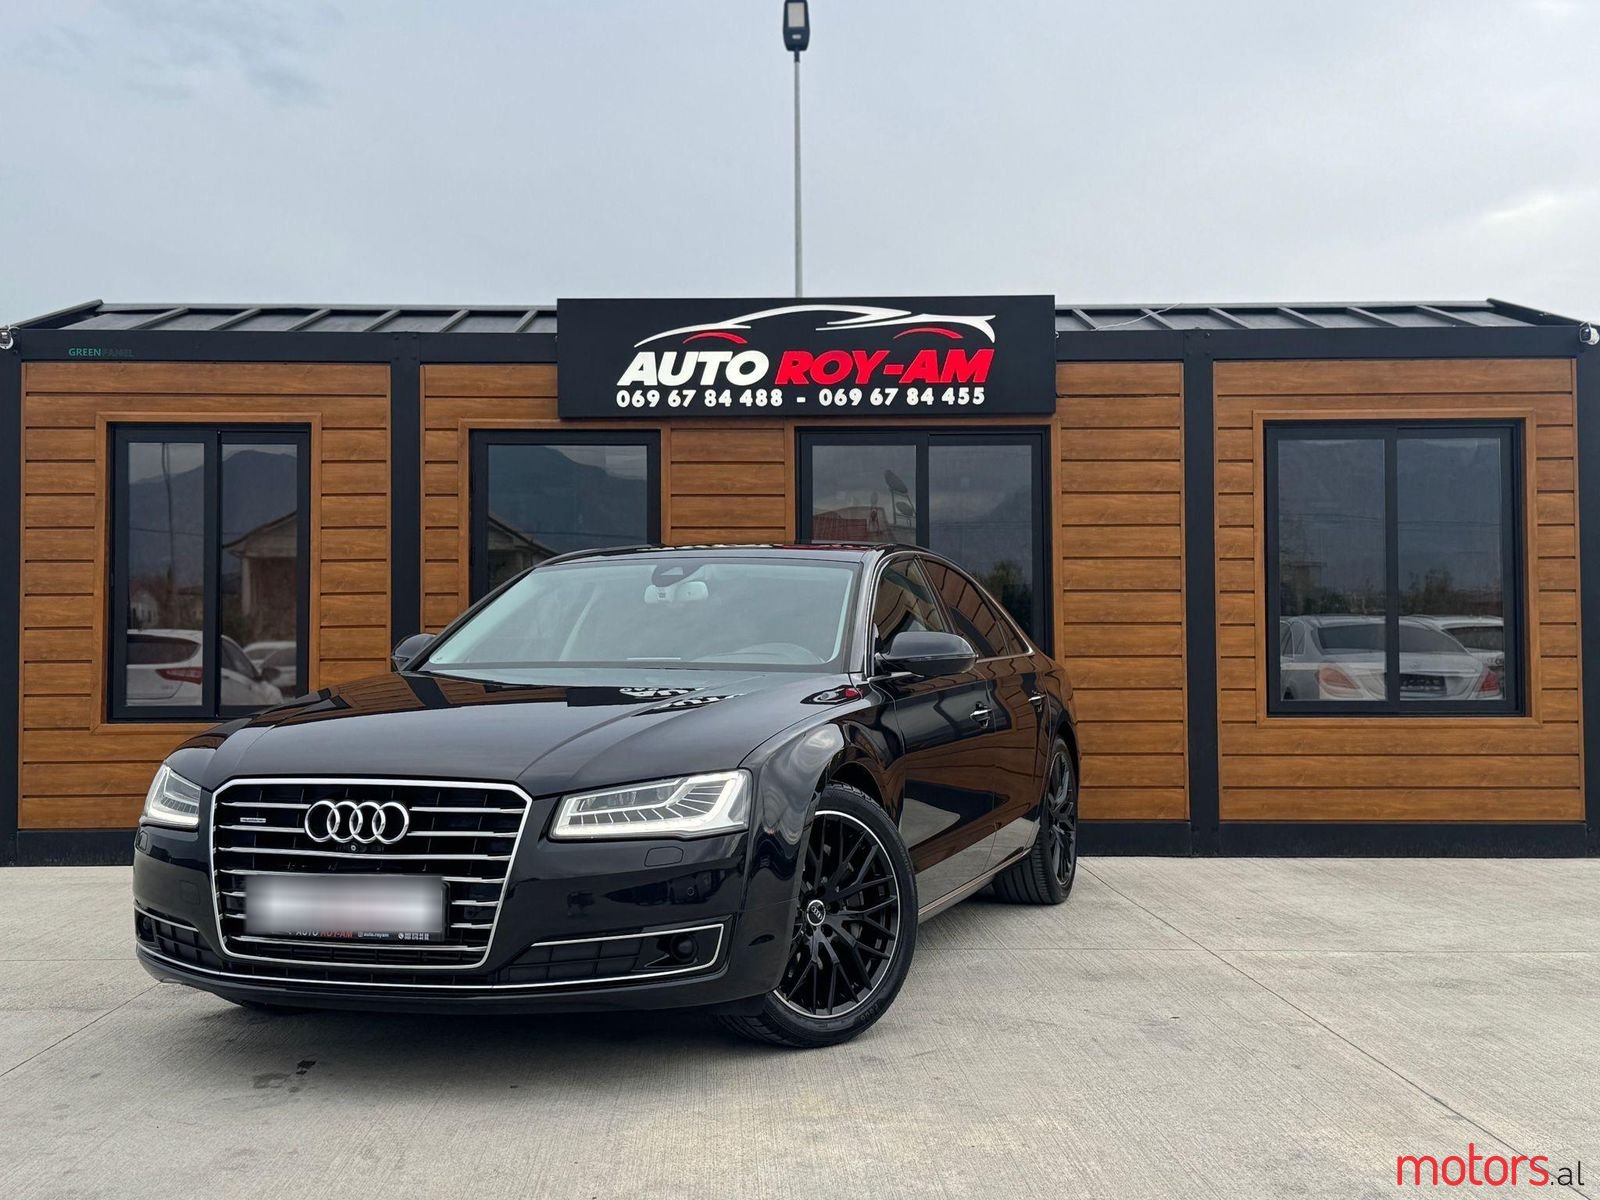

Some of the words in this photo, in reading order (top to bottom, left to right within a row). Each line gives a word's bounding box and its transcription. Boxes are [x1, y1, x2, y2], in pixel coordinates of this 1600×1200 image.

[616, 350, 770, 386] AUTO
[774, 348, 995, 385] ROY-AM
[616, 389, 661, 408] 069
[667, 389, 697, 408] 67
[704, 388, 732, 408] 84
[739, 388, 783, 407] 488
[818, 387, 863, 407] 069
[869, 387, 899, 406] 67
[906, 387, 935, 406] 84
[941, 386, 985, 406] 455
